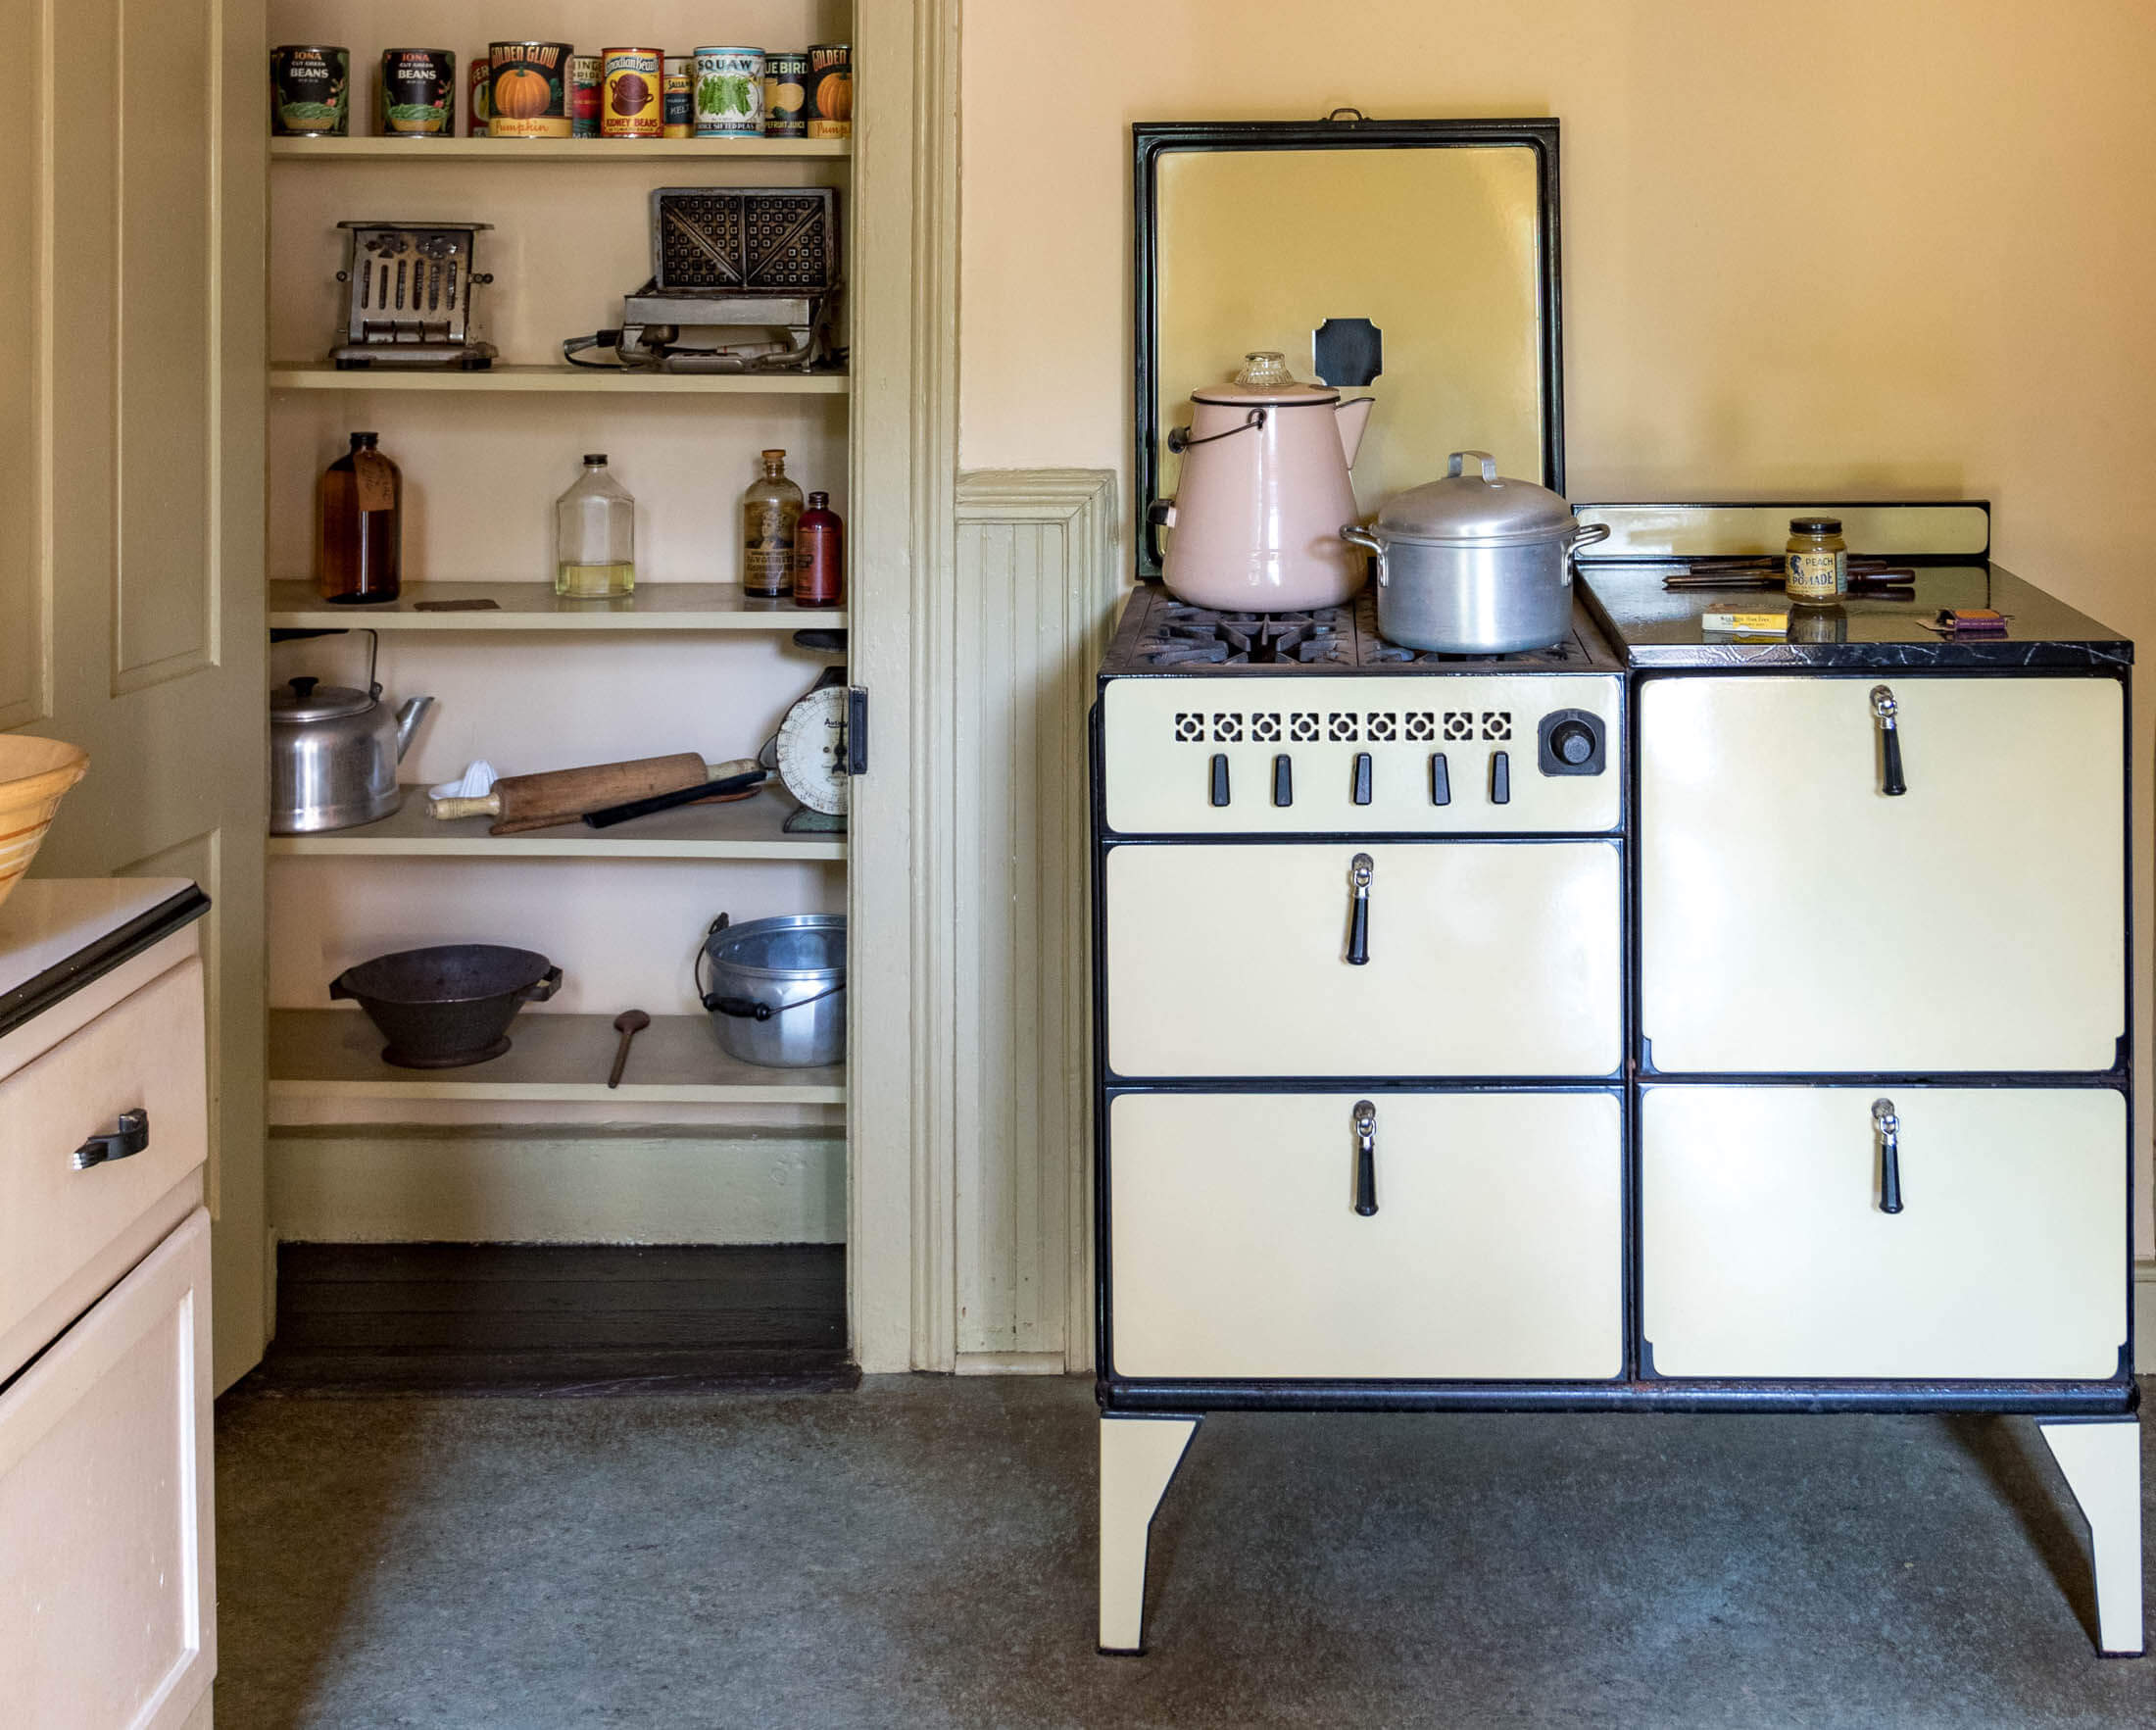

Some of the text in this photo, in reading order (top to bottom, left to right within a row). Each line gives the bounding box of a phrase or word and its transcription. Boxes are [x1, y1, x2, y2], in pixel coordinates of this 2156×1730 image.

[402, 53, 430, 62] IONA
[491, 46, 560, 70] GOLDEN GLOW
[812, 49, 848, 72] GOLDEN
[697, 59, 753, 72] SQUAW
[290, 68, 329, 78] BEANS
[398, 70, 437, 79] BEANS
[494, 120, 550, 134] Pumpkin
[606, 119, 659, 127] KIDNEY BEANS
[1805, 557, 1834, 567] PEACH
